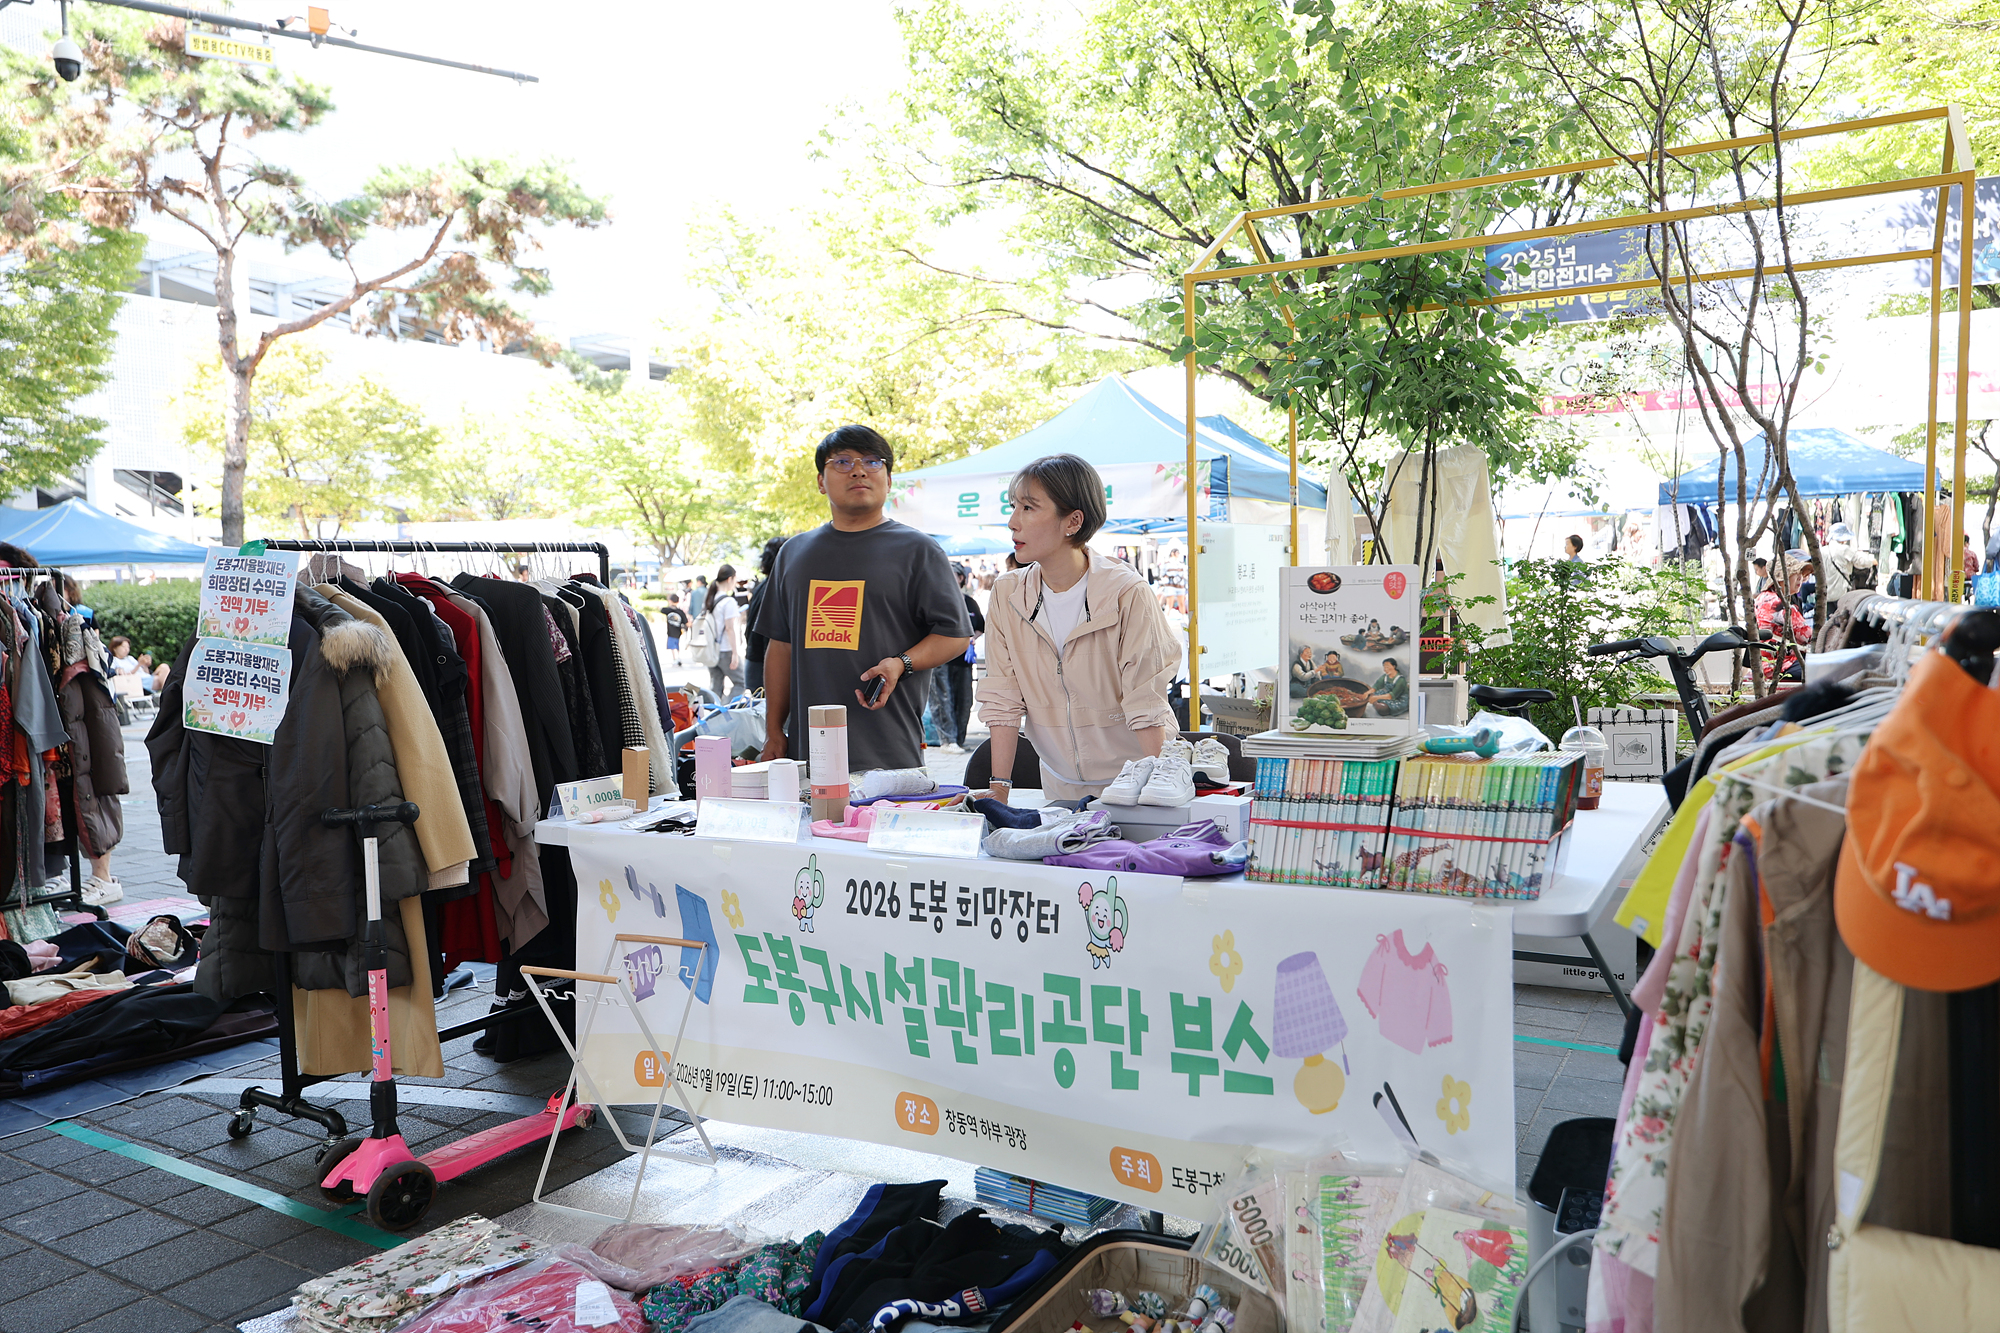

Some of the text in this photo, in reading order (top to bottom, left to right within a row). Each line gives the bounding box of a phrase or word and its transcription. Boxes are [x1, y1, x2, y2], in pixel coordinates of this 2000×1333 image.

[1500, 245, 1577, 271] 2025년
[215, 558, 286, 576] 도봉구자율방재단
[208, 574, 287, 597] 희망장터 수익금
[220, 595, 269, 616] 전액 기부
[1300, 602, 1337, 611] 아삭아삭
[1300, 614, 1368, 623] 나는 김치가 좋아
[810, 629, 852, 643] Kodak
[204, 649, 280, 673] 도봉구자율방재단
[196, 665, 281, 694] 희망장터 수익금
[212, 688, 266, 712] 전액 기부
[586, 789, 622, 805] 1,000원
[1891, 861, 1951, 921] LA
[845, 878, 1060, 943] 2026 도봉 희망장터
[1563, 967, 1586, 977] little
[734, 932, 1274, 1097] 도봉구시설관리공단 부스
[676, 1062, 698, 1089] 2026년
[700, 1068, 713, 1093] 9월
[715, 1071, 759, 1100] 19일(토)
[763, 1077, 833, 1107] 11:00~15:00
[945, 1108, 978, 1138] 창동역
[980, 1117, 1003, 1144] 하부
[1004, 1124, 1028, 1151] 광장
